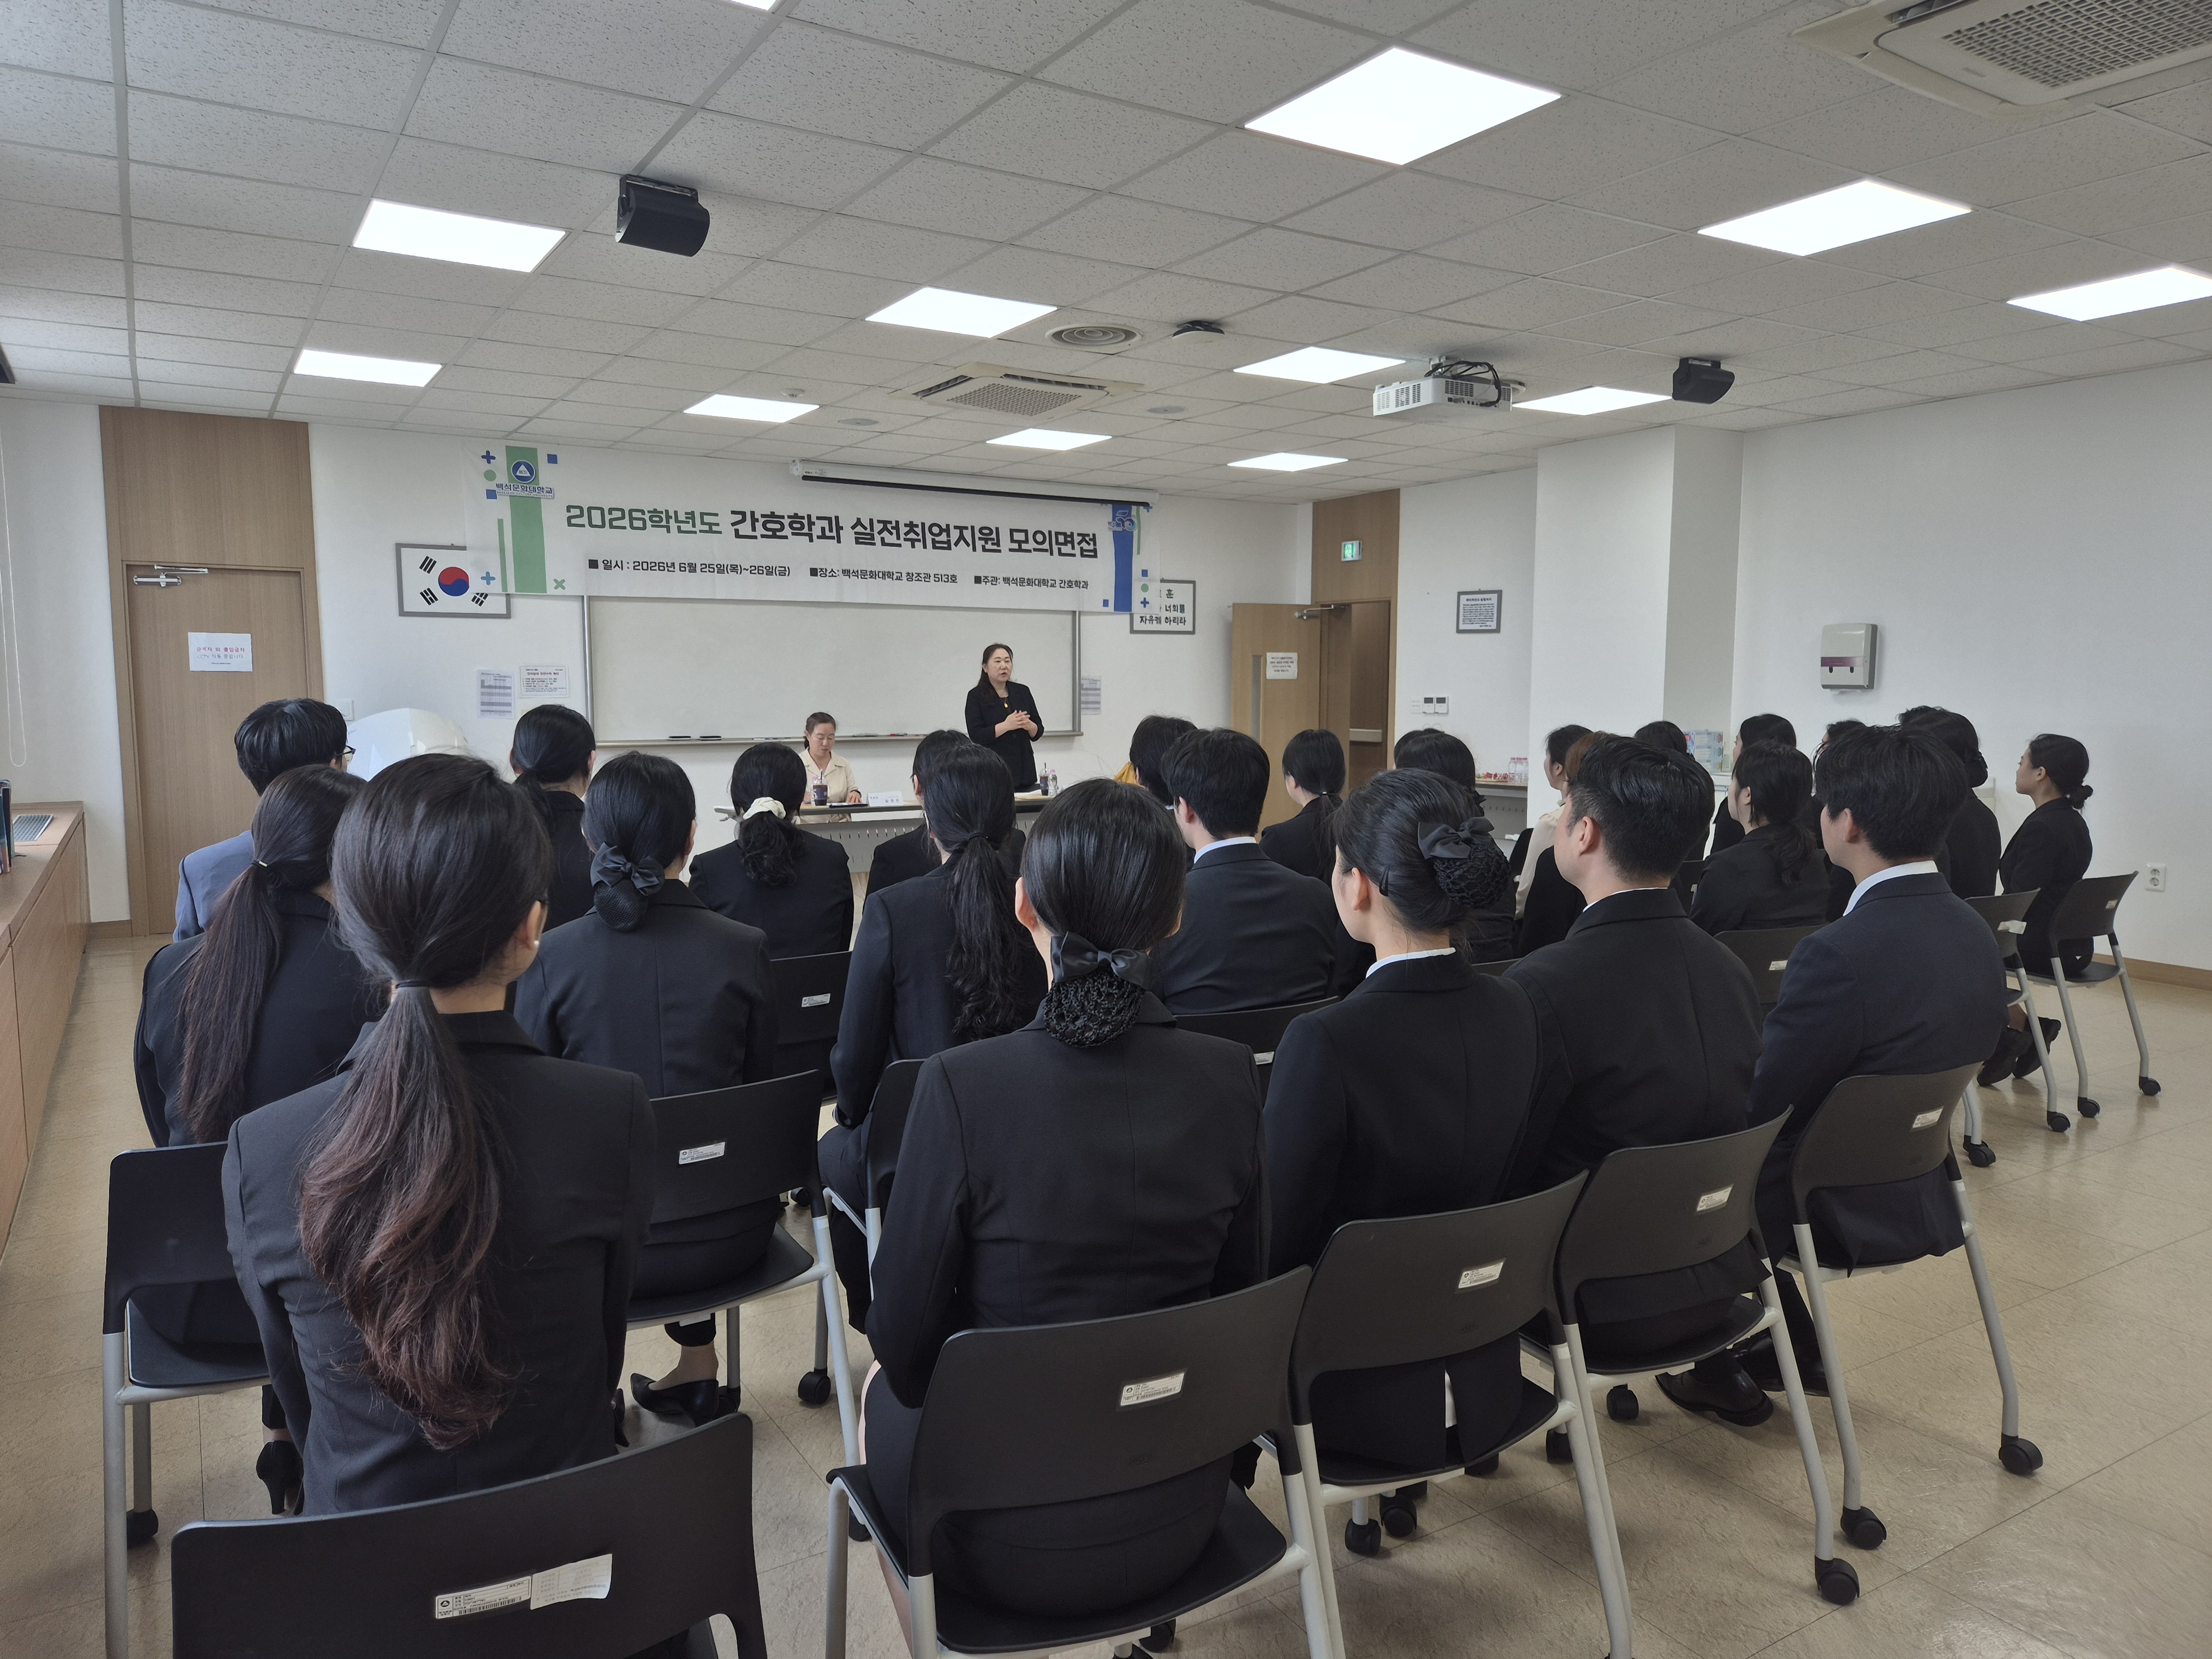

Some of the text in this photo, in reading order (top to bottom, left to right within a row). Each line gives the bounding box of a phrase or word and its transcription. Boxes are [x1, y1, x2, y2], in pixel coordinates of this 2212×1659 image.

[496, 483, 552, 494] 백석문화대학교
[566, 505, 1098, 559] 2026학년도 간호학과 실전취업지원 모의면접
[602, 560, 623, 571] 일시
[633, 561, 675, 572] 2026년
[679, 562, 697, 573] 6월
[700, 563, 790, 577] 25일(목)~26일(금)
[842, 568, 903, 581] 백석문화대학교
[905, 572, 931, 582] 창조관
[933, 573, 958, 583] 513호
[1003, 577, 1057, 588] 백석문화대학교
[1058, 580, 1088, 589] 간호학과
[1166, 588, 1174, 598] 훈
[1165, 616, 1186, 625] 하리라
